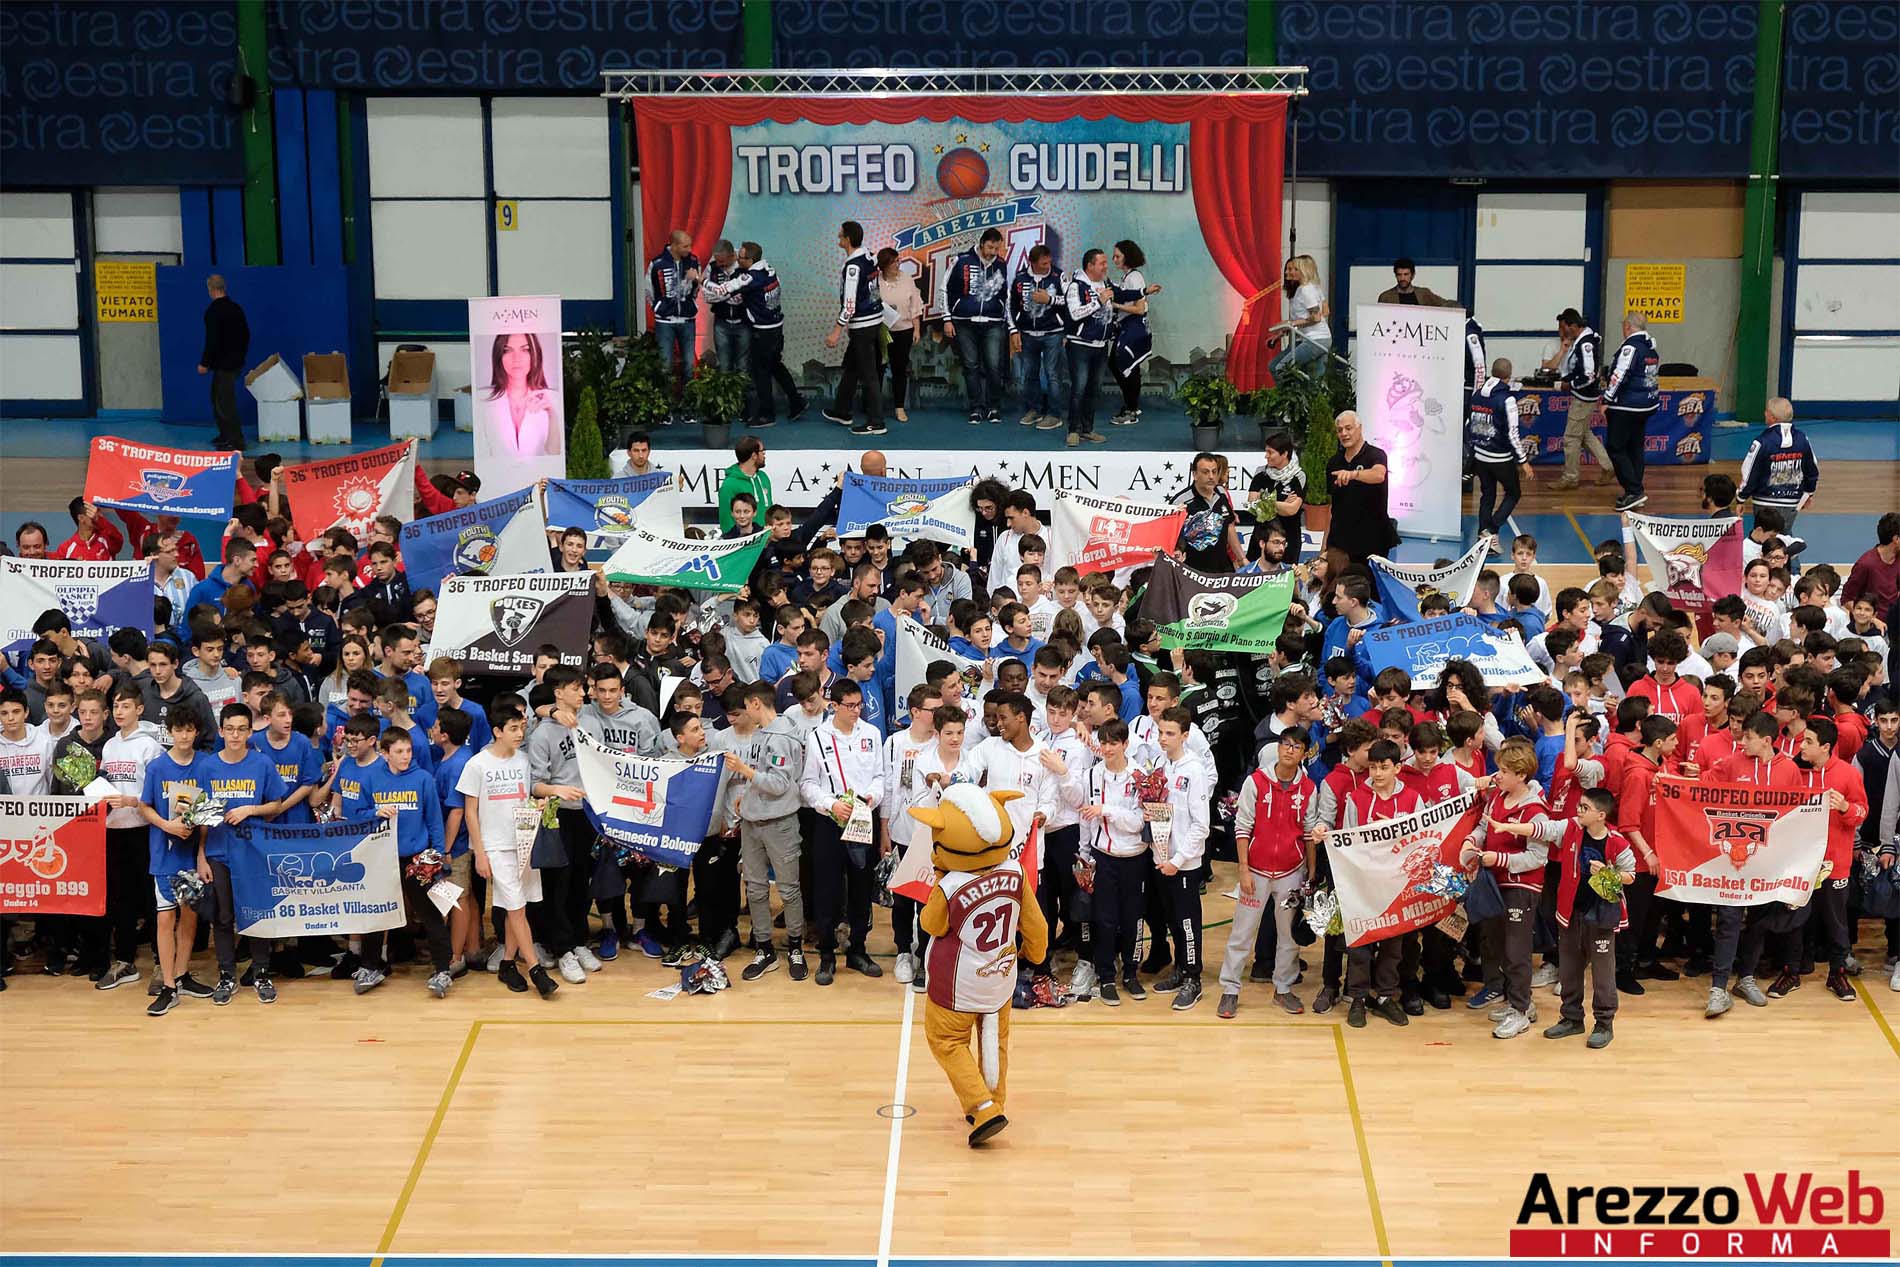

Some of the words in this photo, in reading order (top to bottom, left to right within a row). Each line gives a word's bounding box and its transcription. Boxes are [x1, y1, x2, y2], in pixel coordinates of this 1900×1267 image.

[1324, 0, 1457, 41] estra
[1509, 0, 1641, 41] estra
[267, 39, 366, 83] stra
[417, 41, 549, 86] estra
[1397, 48, 1527, 92] estra
[1581, 48, 1713, 92] estra
[1785, 46, 1853, 91] tra
[64, 55, 199, 97] estra
[0, 105, 90, 149] stra
[141, 105, 235, 149] estr
[1470, 100, 1600, 144] estra
[1654, 100, 1752, 144] estr
[738, 144, 915, 193] TROFEO
[1010, 143, 1185, 192] GUIDELLI
[503, 204, 512, 226] 9
[922, 208, 1006, 244] AREZZO
[101, 296, 154, 306] VIETATO
[1628, 297, 1681, 307] VIETATO
[101, 308, 153, 318] FUMARE
[511, 309, 538, 323] MEN
[1628, 310, 1680, 319] MARE
[1371, 321, 1384, 337] A
[1403, 321, 1449, 347] MEN
[1678, 402, 1704, 417] SBA
[121, 444, 171, 464] TROFEO
[174, 454, 232, 468] GUIDELLI
[1676, 443, 1702, 458] SBA
[312, 460, 359, 480] TROFEO
[1022, 461, 1100, 491] MEN
[1128, 466, 1152, 491] A
[572, 483, 619, 495] TROFEO
[679, 464, 727, 504] ME
[786, 467, 810, 492] A
[871, 480, 917, 493] TROFEO
[602, 496, 625, 504] YOUTH
[1075, 495, 1122, 513] TROFEO
[404, 524, 423, 539] 36°
[426, 512, 477, 534] TROFEO
[461, 526, 489, 538] YOUTH
[922, 515, 967, 537] Leonessa
[1649, 522, 1690, 538] TROFEO
[661, 538, 708, 551] TROFEO
[1068, 549, 1107, 566] Oderzo
[30, 565, 83, 578] TROFEO
[1182, 564, 1229, 589] TROFEO
[449, 580, 470, 593] 36°
[474, 578, 526, 592] TROFEO
[495, 596, 537, 610] DUKES
[71, 627, 103, 639] asket
[1397, 618, 1451, 640] TROFEO
[1221, 632, 1230, 643] di
[1231, 635, 1253, 647] Piano
[1256, 639, 1274, 647] 2014
[469, 647, 510, 663] Basket
[489, 663, 510, 671] Under
[604, 728, 636, 746] ALUS
[486, 769, 524, 783] SALUS
[615, 761, 660, 782] SALUS
[694, 766, 716, 774] AREZZO
[211, 779, 256, 792] VILLASANTA
[372, 791, 418, 803] VILLASANTA
[1662, 784, 1686, 799] 36°
[1690, 786, 1749, 805] TROFEO
[1753, 789, 1822, 806] GUIDELLI
[29, 801, 98, 817] GUIDELLI
[263, 825, 321, 841] TROFEO
[325, 818, 391, 838] GUIDELLI
[1332, 832, 1355, 848] 36°
[1360, 817, 1418, 844] TROFEO
[661, 834, 701, 855] Bologn
[1391, 830, 1443, 855] URANIA
[56, 881, 89, 896] B99
[272, 885, 308, 896] BASKET
[311, 883, 366, 896] VILLASANTA
[957, 870, 1019, 909] AREZZO
[1692, 873, 1746, 890] Basket
[1750, 874, 1810, 893] Cinisello
[3, 899, 27, 907] Under
[29, 899, 38, 907] 14
[1719, 891, 1742, 900] Under
[1744, 892, 1753, 900] 14
[241, 906, 276, 920] Team
[279, 904, 296, 918] 86
[299, 903, 340, 916] Basket
[343, 900, 398, 914] Villasanta
[305, 922, 323, 930] Under
[972, 902, 1013, 952] 27
[1350, 912, 1399, 934] Urania
